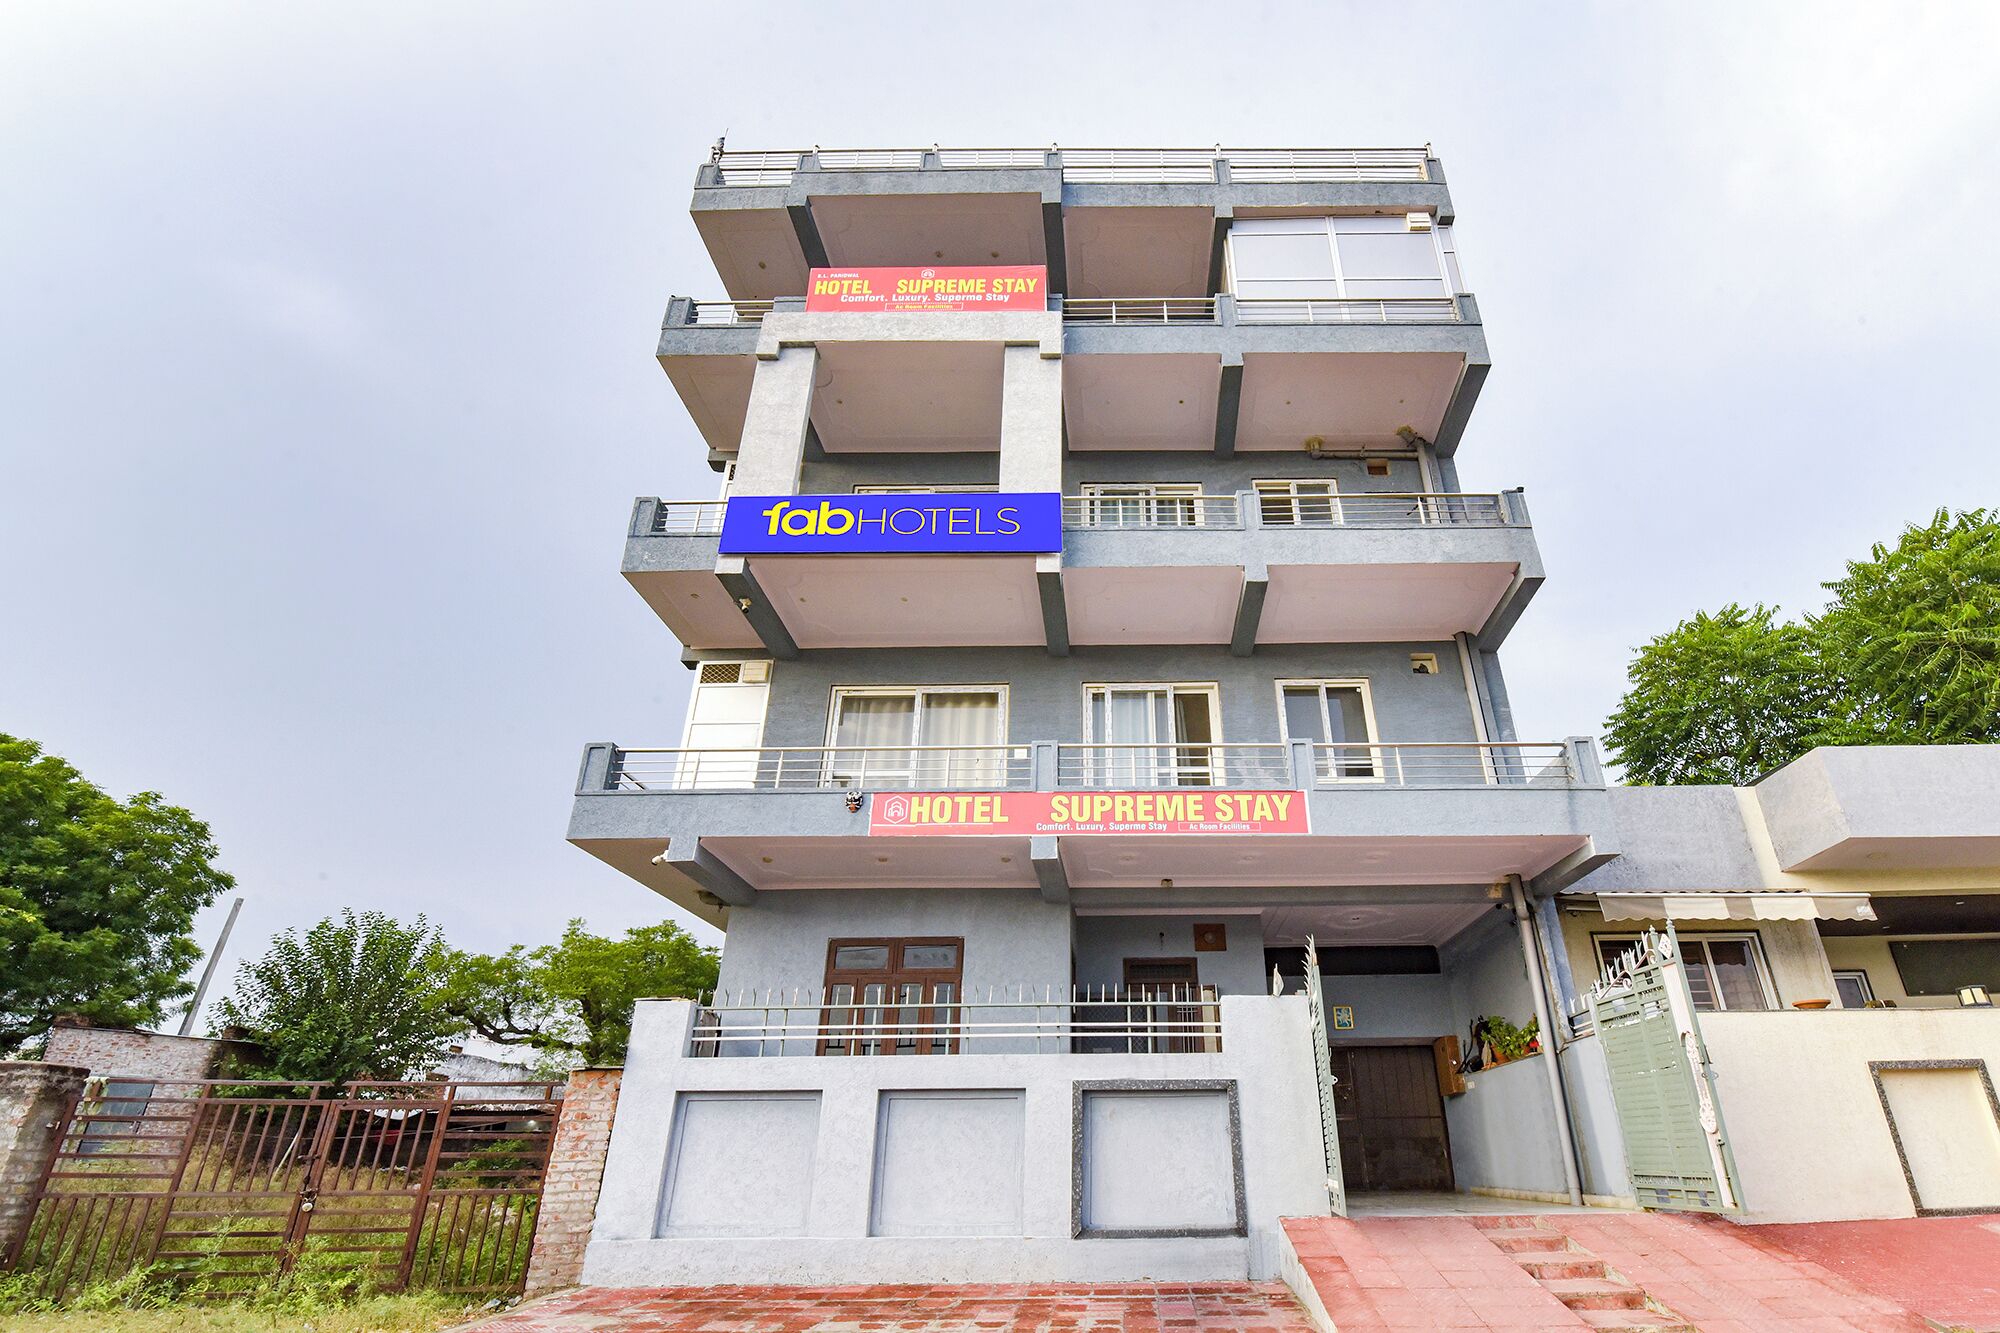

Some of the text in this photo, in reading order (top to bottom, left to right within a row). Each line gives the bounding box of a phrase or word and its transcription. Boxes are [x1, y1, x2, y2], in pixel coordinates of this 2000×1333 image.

[814, 278, 1038, 295] HOTEL SUPREME STAY
[985, 293, 1010, 303] Stay
[909, 794, 1292, 823] HOTEL SUPREME STAY
[1109, 822, 1146, 832] Superme
[1148, 822, 1167, 832] Stay
[1219, 822, 1250, 831] Facilities
